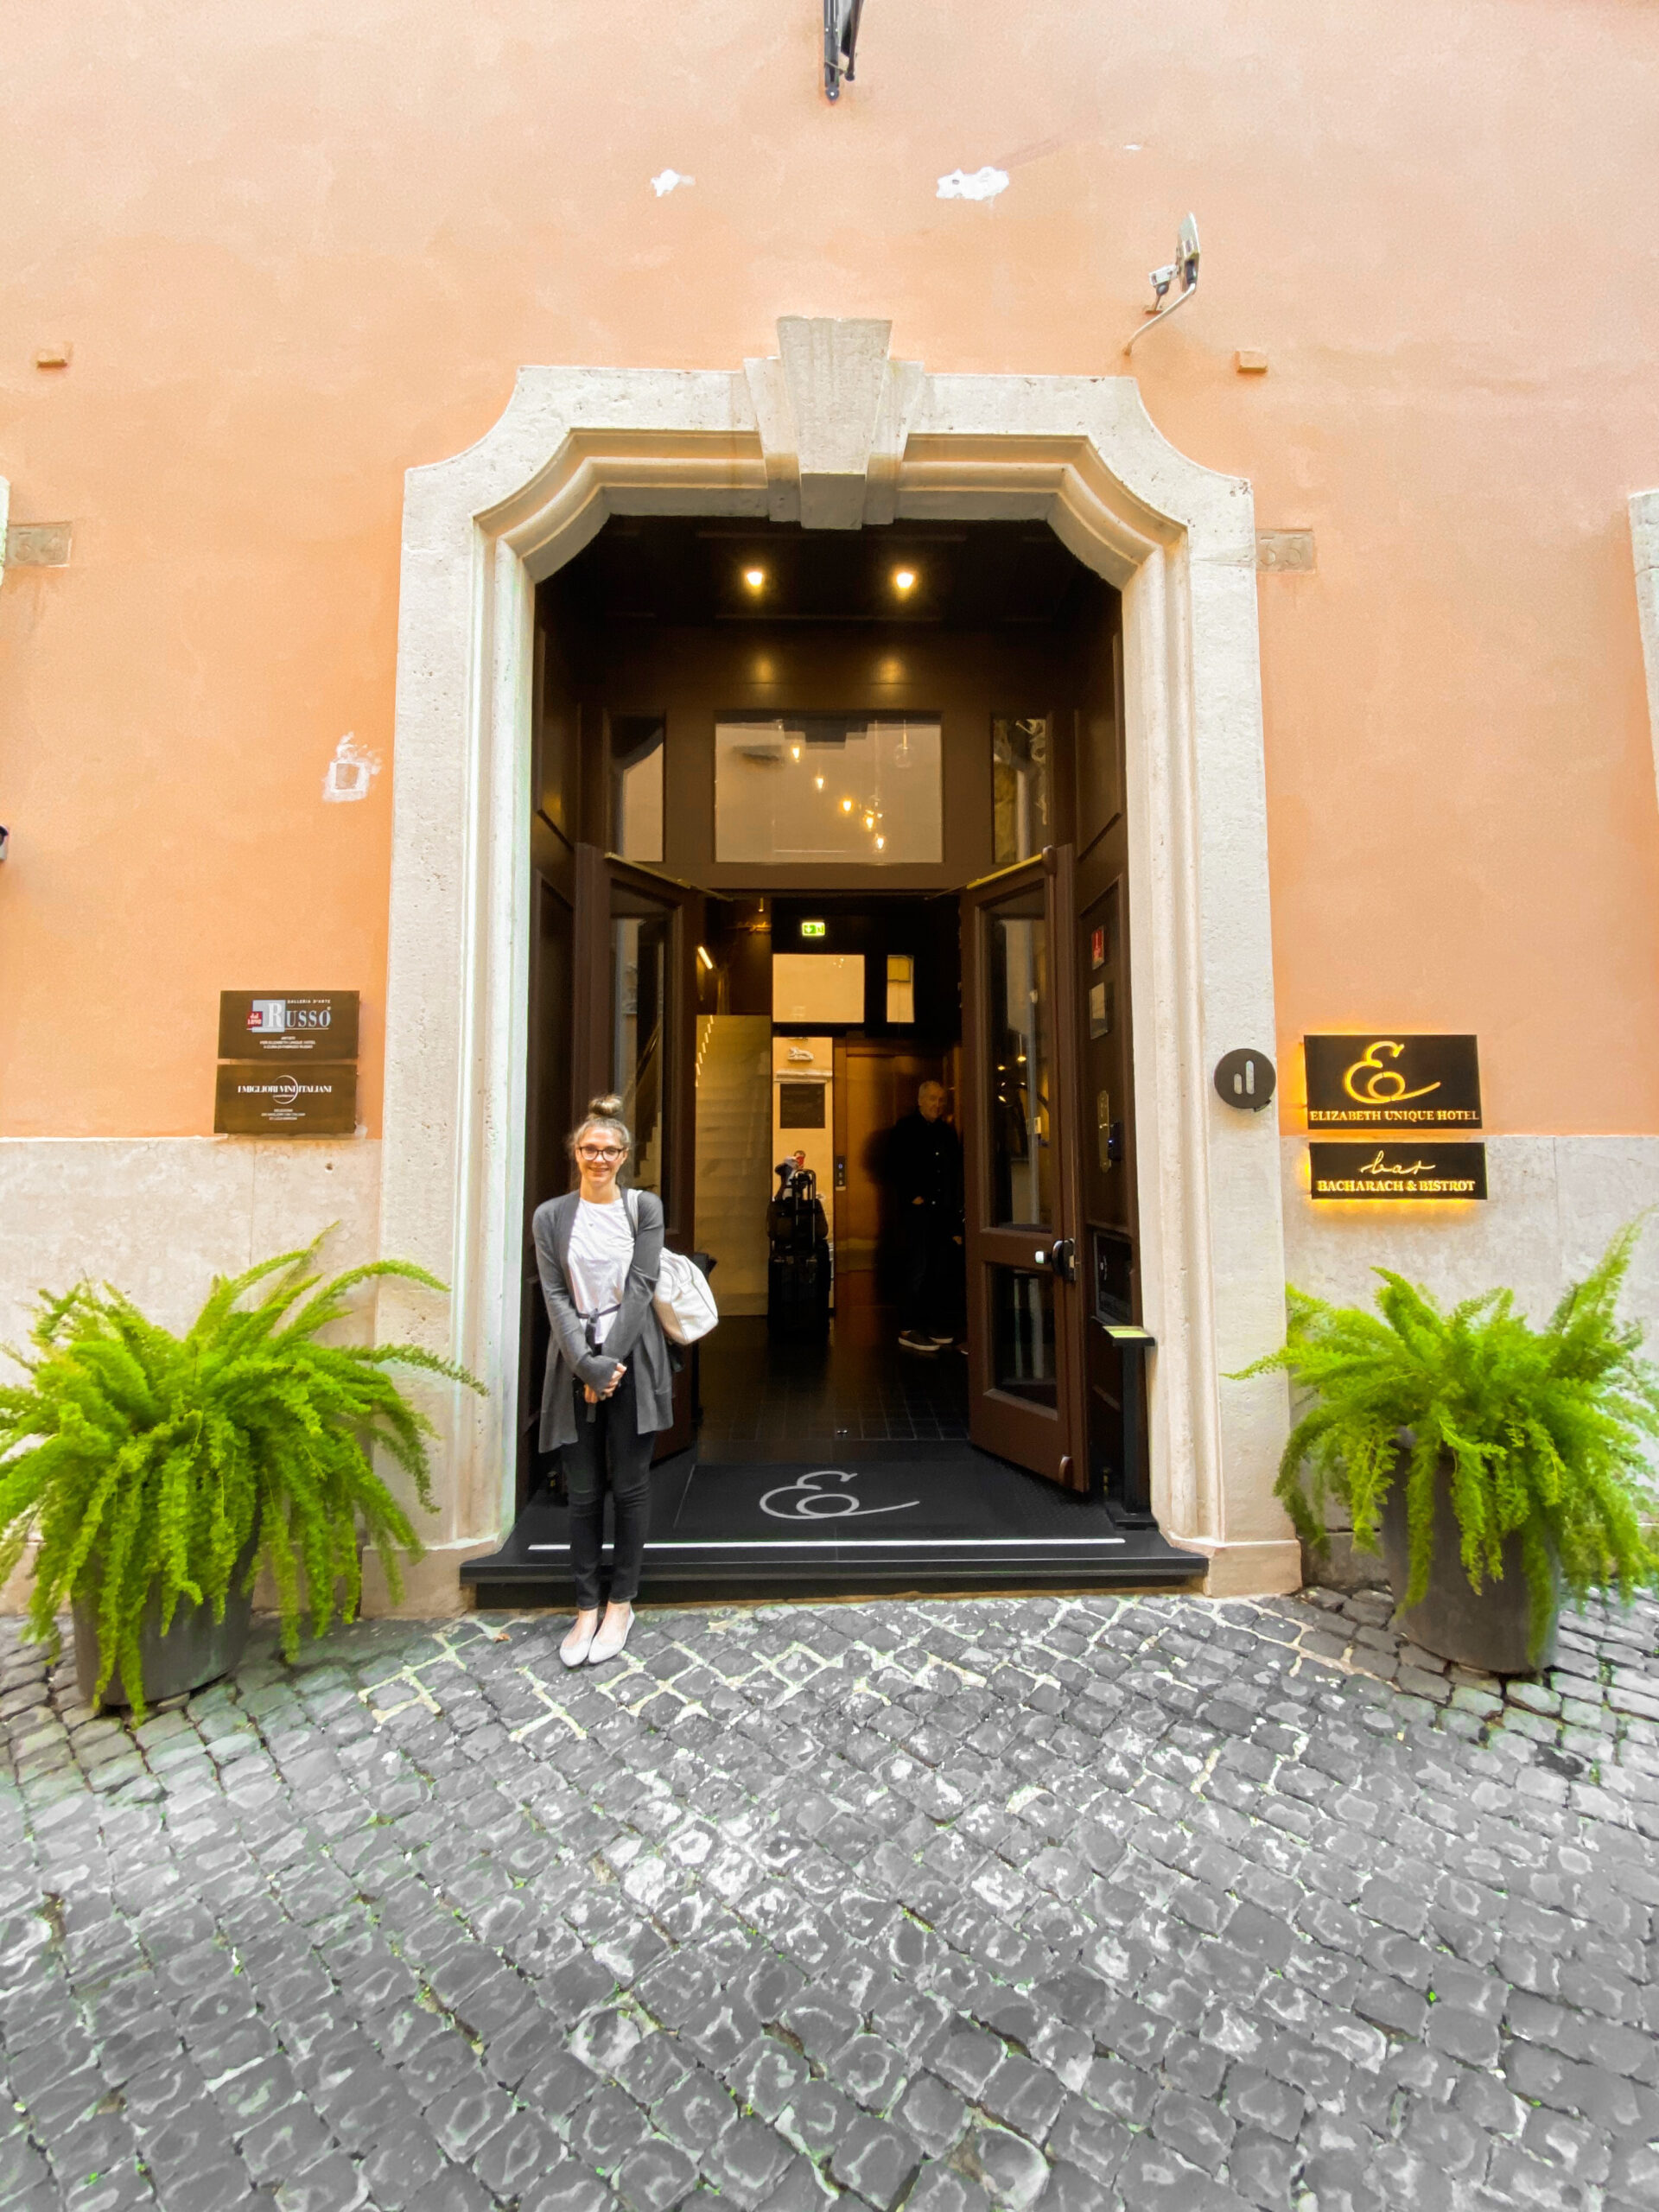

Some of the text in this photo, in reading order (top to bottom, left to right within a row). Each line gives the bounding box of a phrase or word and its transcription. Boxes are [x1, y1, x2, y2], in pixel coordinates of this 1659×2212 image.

[268, 1002, 332, 1028] RUSSO
[1310, 1110, 1479, 1122] ELIZABETH UNIQUE HOTEL
[1360, 1150, 1435, 1174] bar
[1318, 1180, 1475, 1192] BACHARACH & BISTROT
